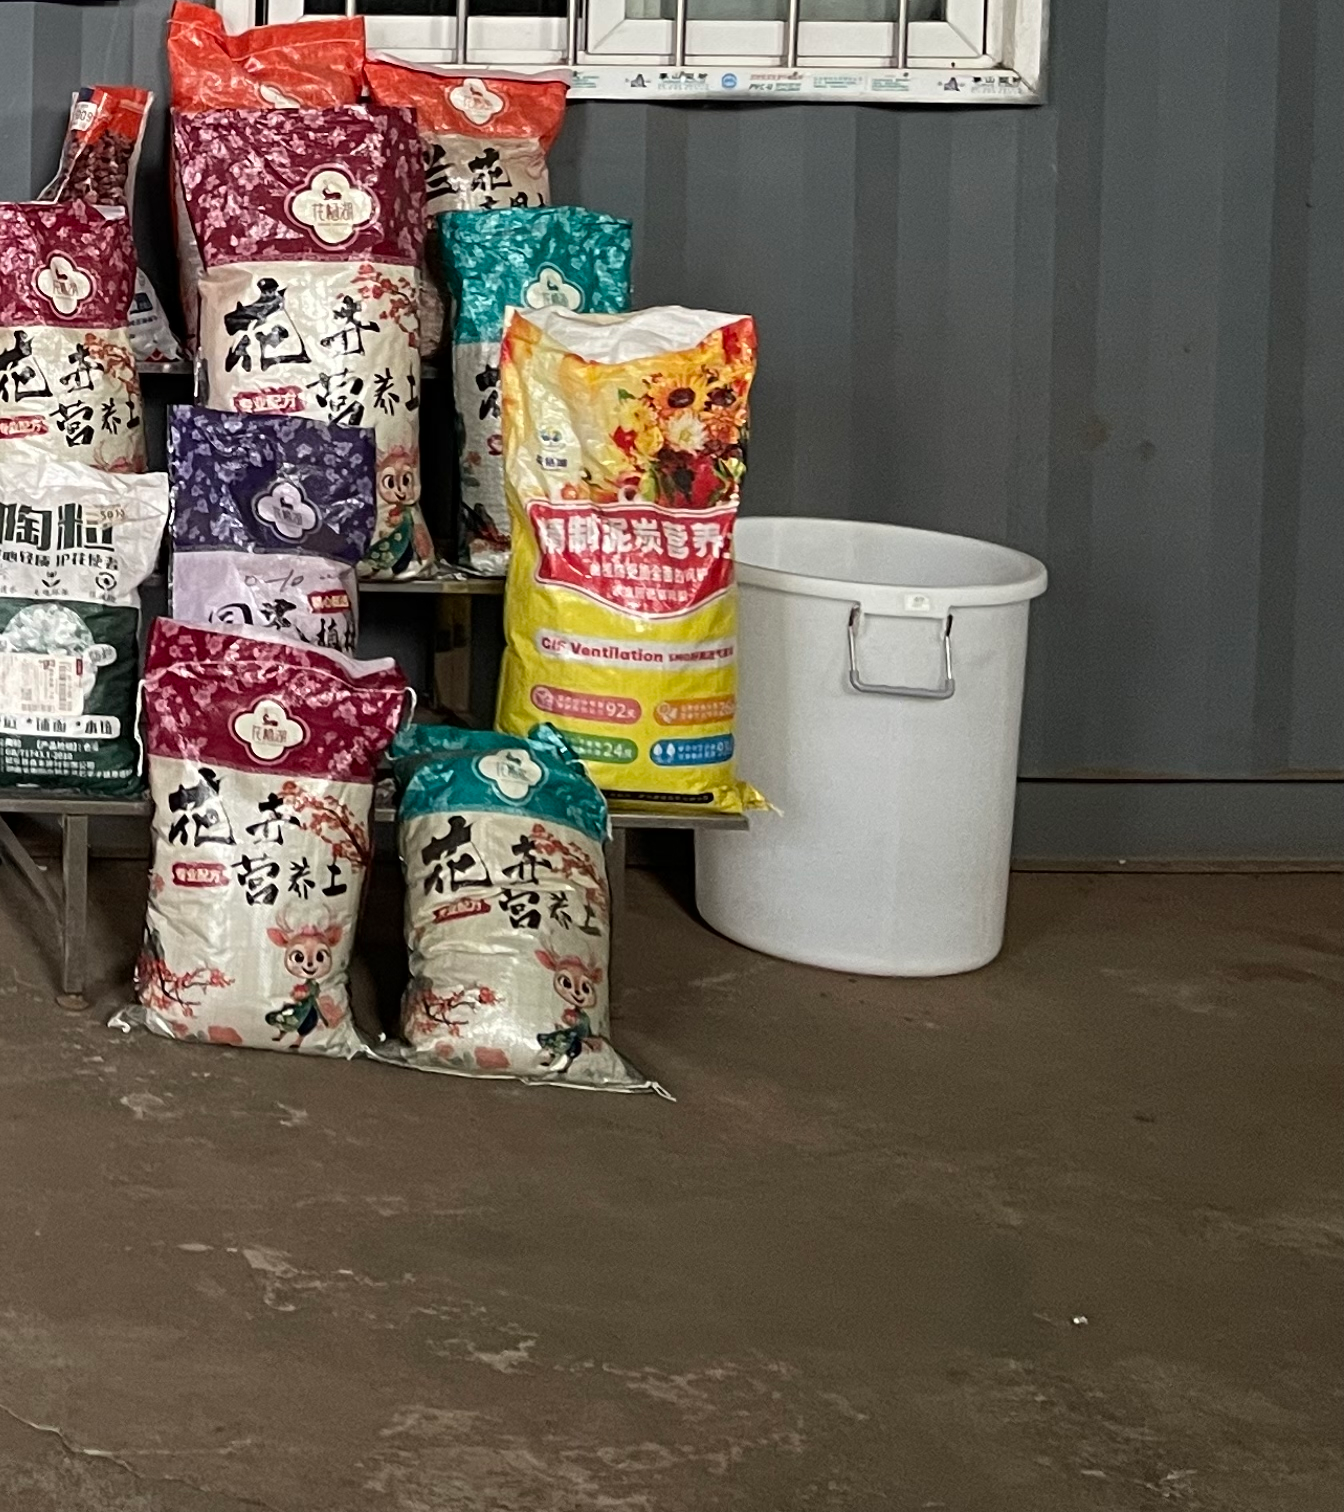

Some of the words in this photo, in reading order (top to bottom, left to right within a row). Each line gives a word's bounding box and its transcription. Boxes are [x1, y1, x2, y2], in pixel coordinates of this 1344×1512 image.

[225, 277, 381, 374] 花卉
[49, 398, 141, 448] 营养土
[570, 641, 664, 664] Ventilation
[169, 768, 301, 848] 花卉
[230, 853, 348, 907] 营养土
[421, 815, 553, 896] 花卉
[499, 887, 602, 937] 营养土
